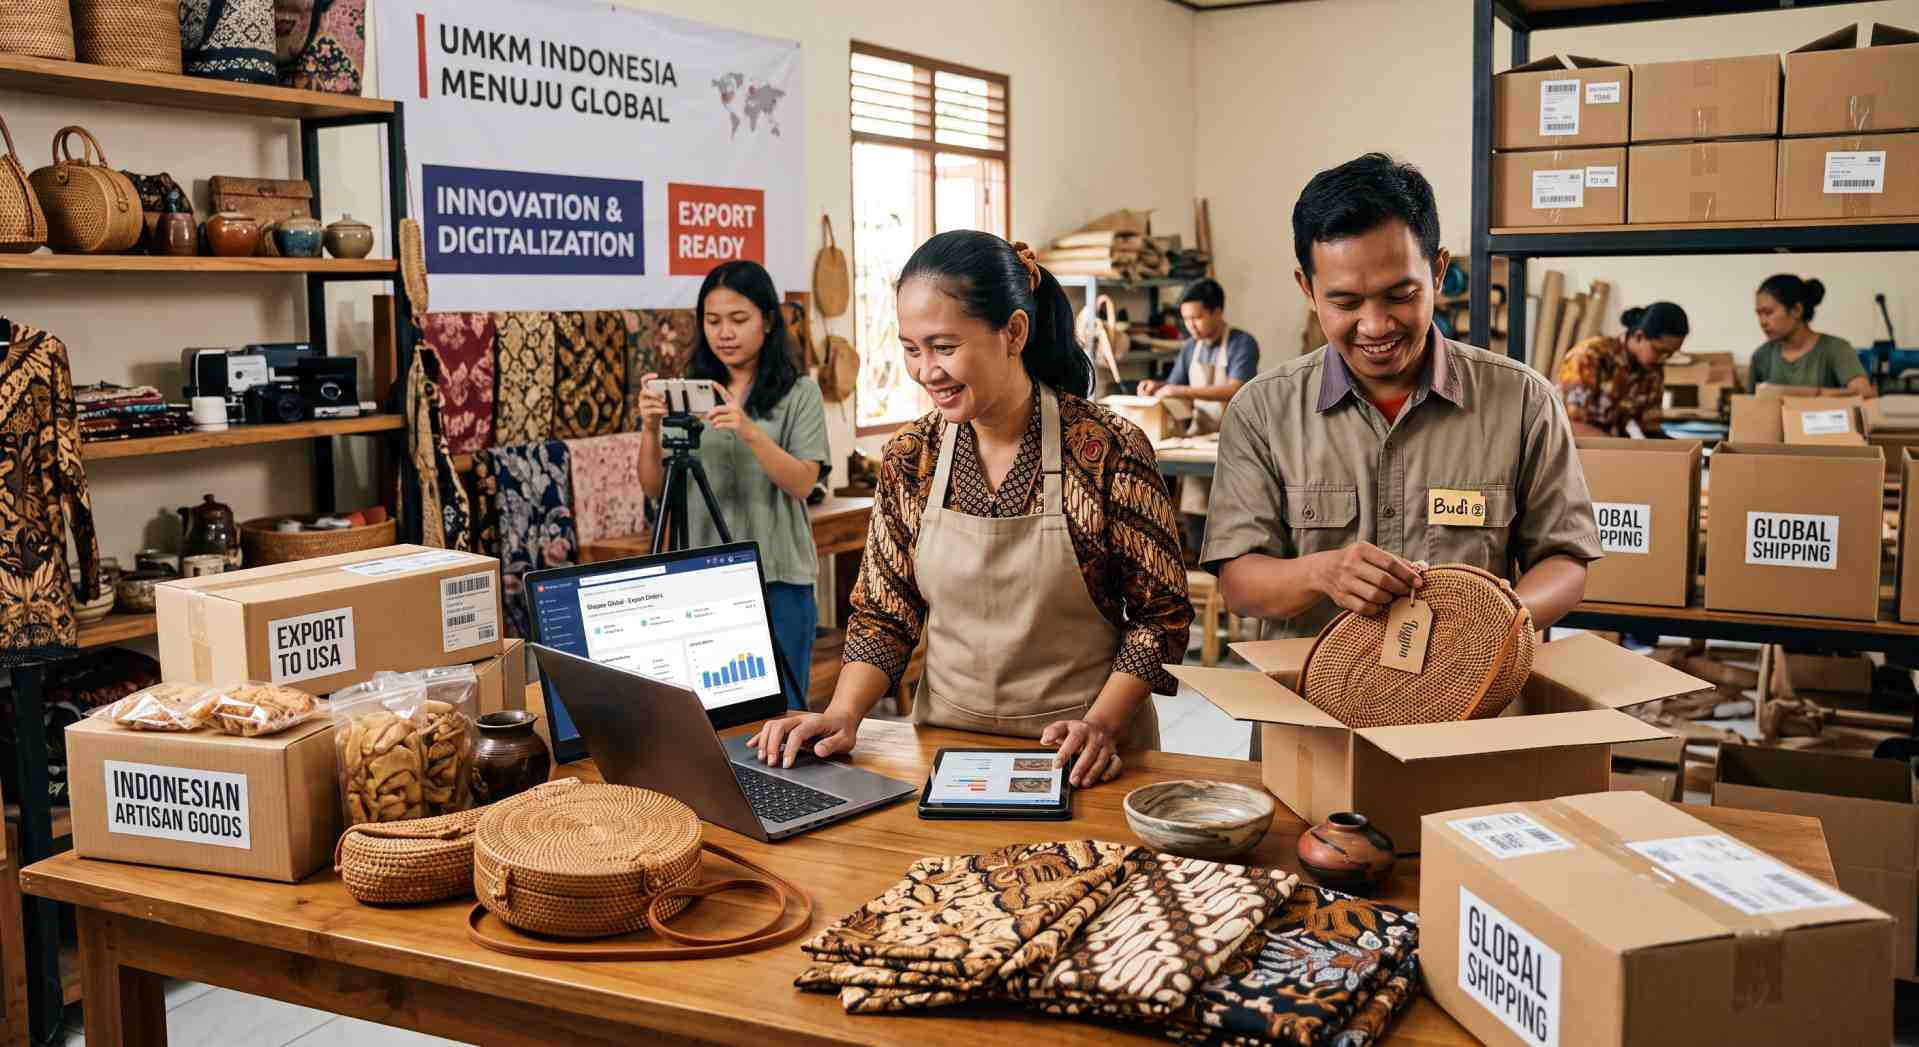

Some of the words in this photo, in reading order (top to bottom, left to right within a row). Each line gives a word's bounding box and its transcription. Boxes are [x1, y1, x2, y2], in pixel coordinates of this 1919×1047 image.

[440, 24, 531, 65] UMKM
[541, 40, 677, 87] INDONESIA
[442, 68, 562, 109] MENUJU
[572, 86, 670, 123] GLOBAL
[437, 186, 600, 222] INNOVATION
[606, 197, 623, 222] &
[678, 202, 756, 228] EXPORT
[438, 226, 635, 257] DIGITALIZATION
[679, 235, 745, 260] READY
[1434, 498, 1468, 515] Budi
[1599, 508, 1642, 528] OBAL
[1600, 530, 1642, 547] PPING
[1754, 518, 1831, 542] GLOBAL
[1753, 541, 1830, 563] SHIPPING
[277, 616, 346, 650] EXPORT
[279, 652, 301, 676] TO
[307, 643, 342, 671] USA
[113, 770, 240, 811] INDONESIAN
[115, 803, 183, 831] ARTISAN
[188, 811, 242, 838] GOODS
[1469, 905, 1547, 1000] GLOBAL
[1468, 952, 1547, 1042] SHIPPING
